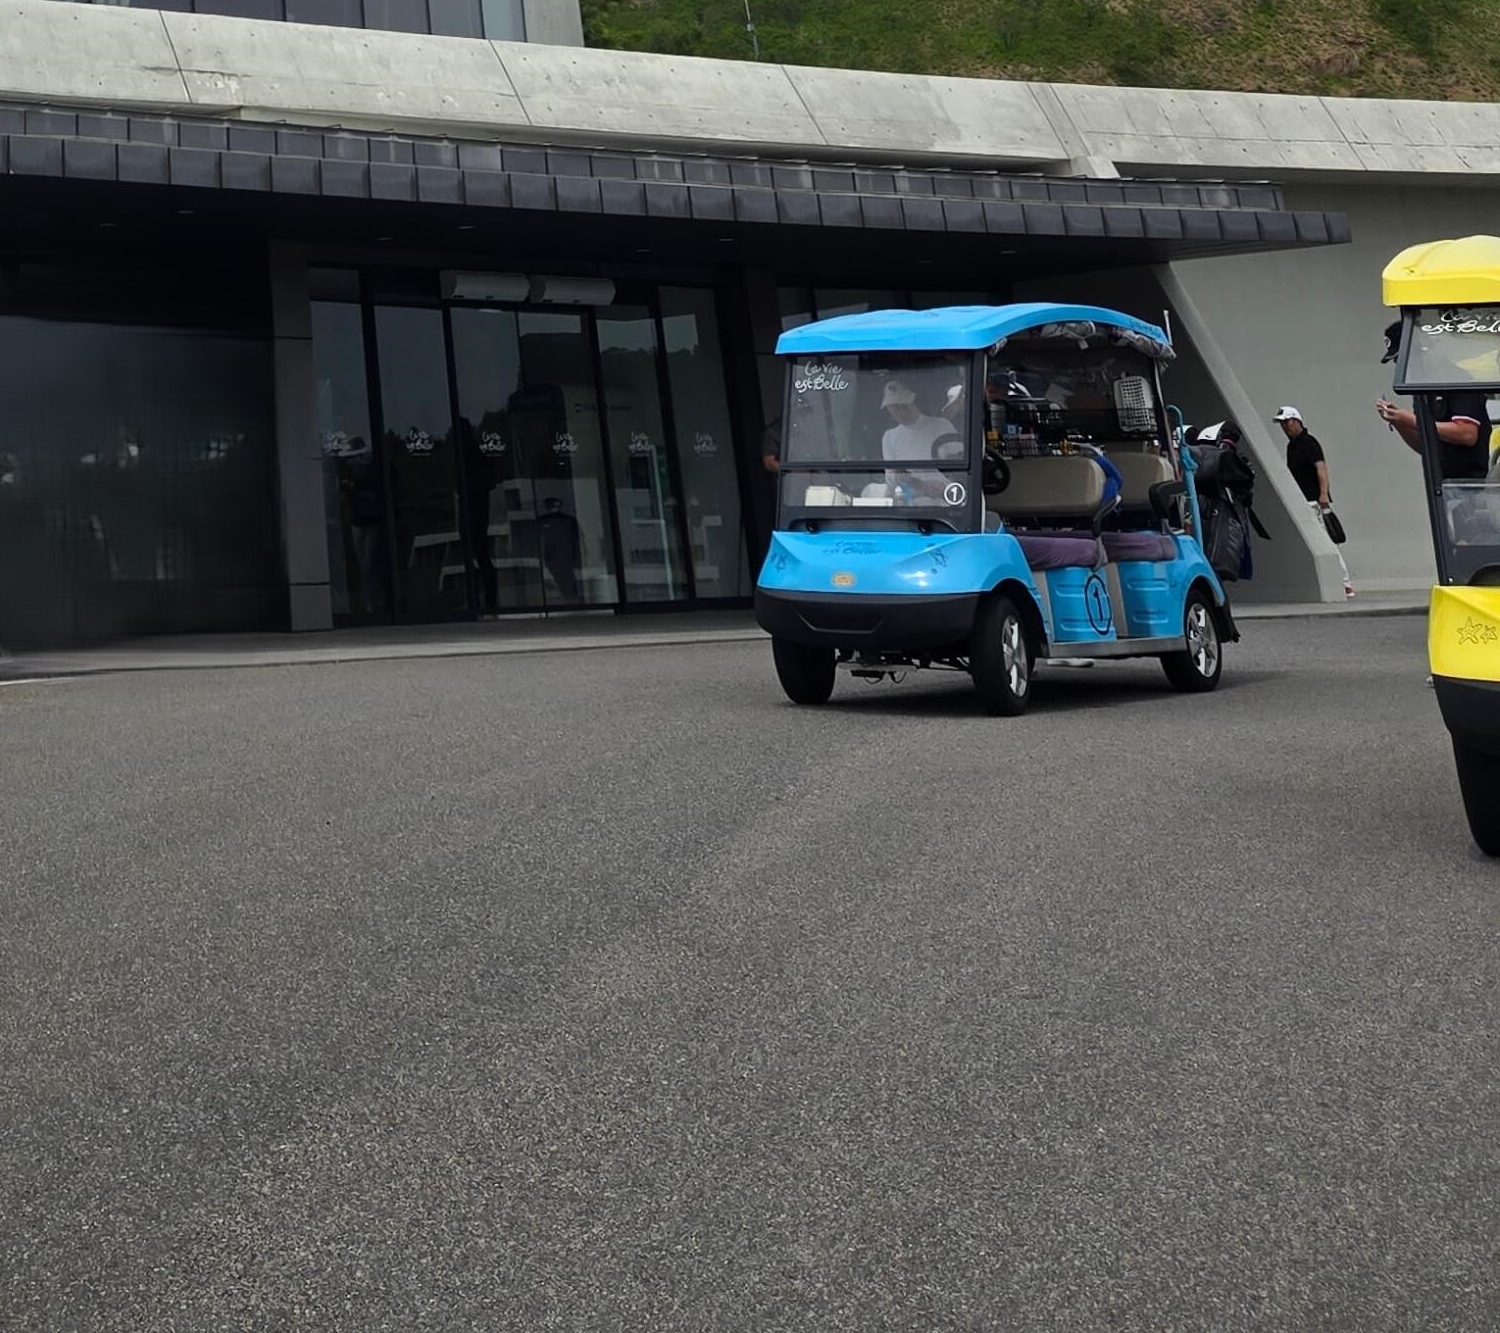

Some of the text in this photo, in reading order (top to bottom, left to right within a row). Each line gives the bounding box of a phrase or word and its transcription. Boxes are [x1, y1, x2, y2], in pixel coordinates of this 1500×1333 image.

[1421, 323, 1454, 335] est
[794, 374, 849, 393] est Belle
